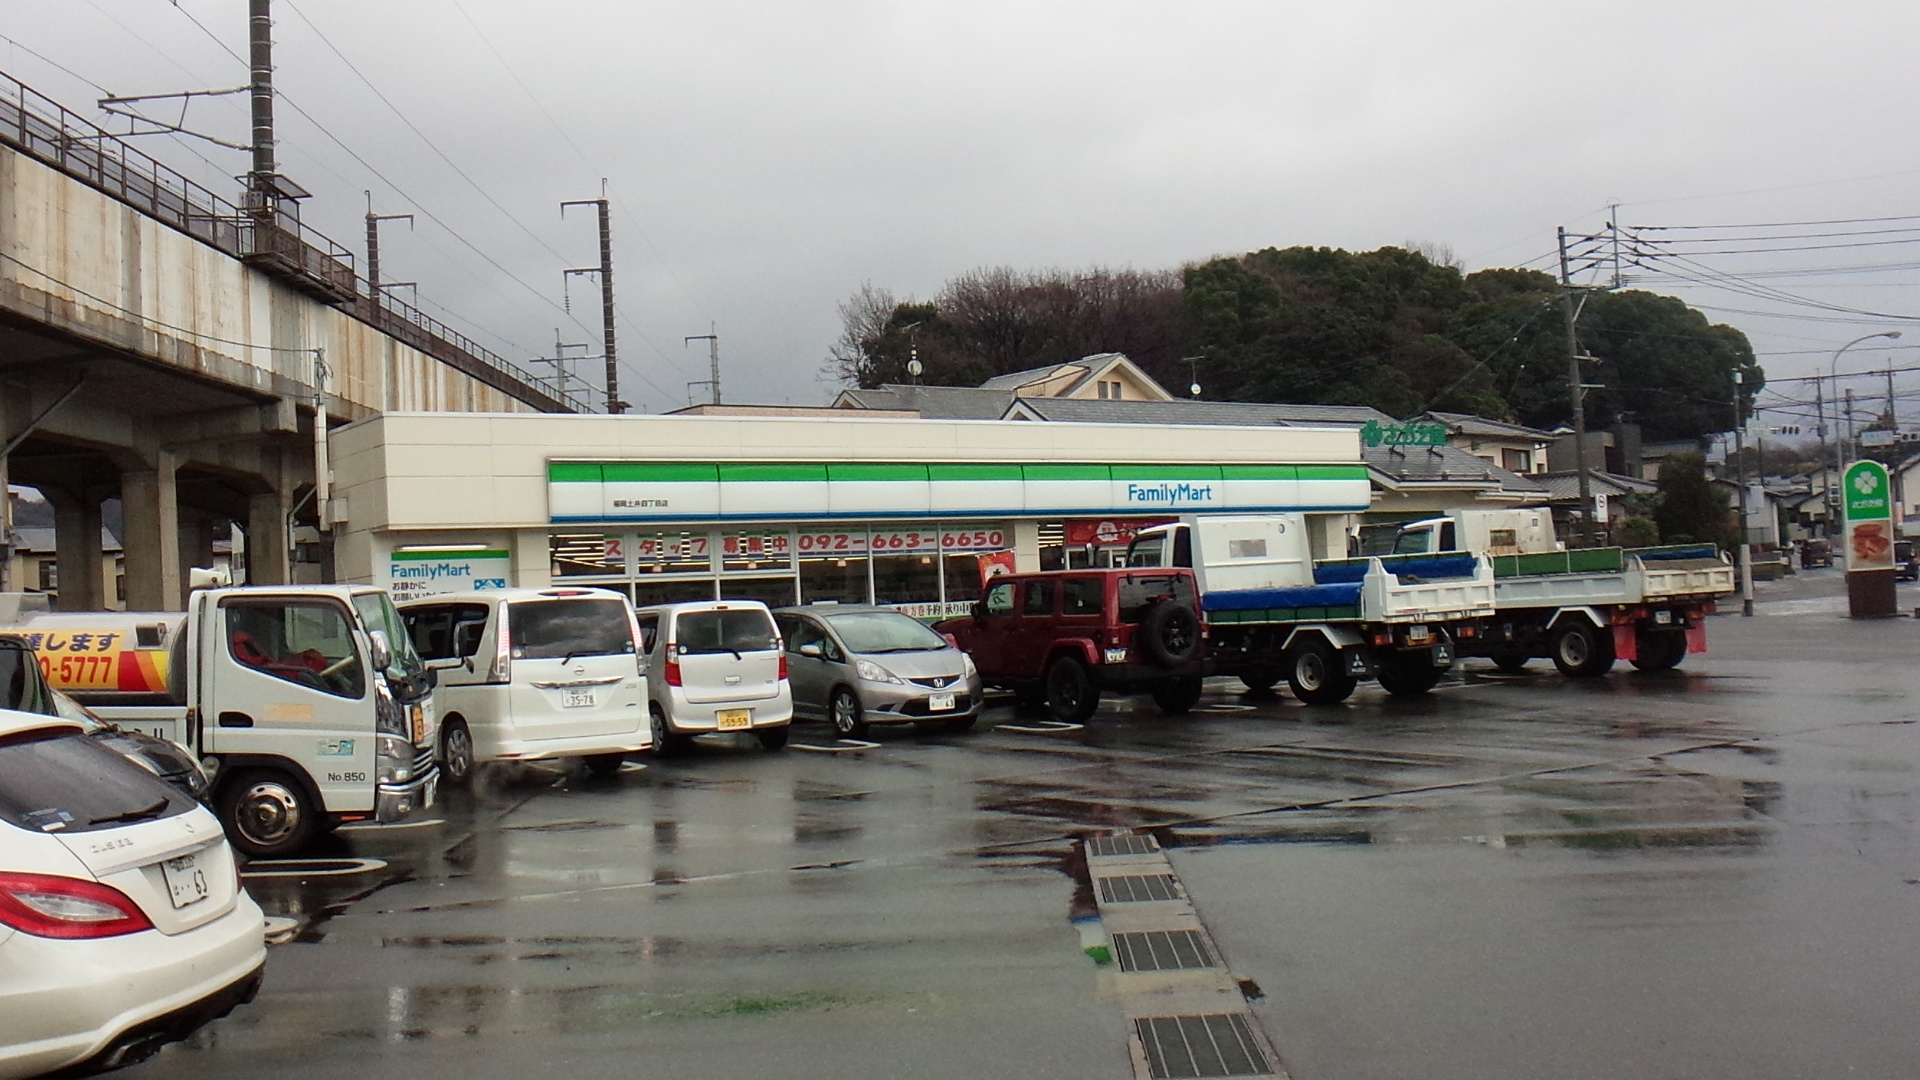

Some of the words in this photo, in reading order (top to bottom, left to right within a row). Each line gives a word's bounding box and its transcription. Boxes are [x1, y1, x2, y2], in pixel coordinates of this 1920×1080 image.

[1128, 483, 1212, 506] FamilyMart
[798, 531, 1003, 550] 092-663-6650
[391, 563, 471, 580] FamilyMart
